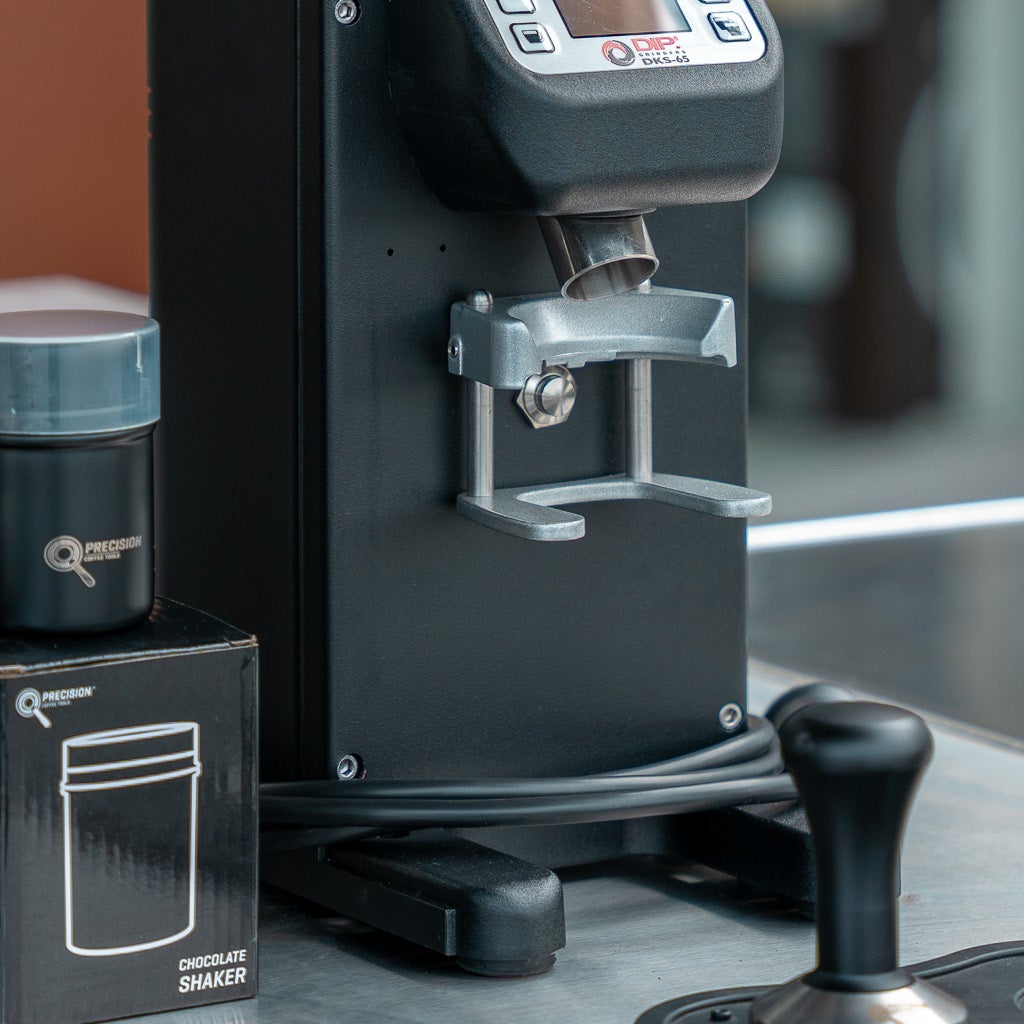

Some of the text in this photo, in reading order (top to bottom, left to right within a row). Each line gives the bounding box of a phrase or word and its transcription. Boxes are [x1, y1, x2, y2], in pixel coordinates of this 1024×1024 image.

[641, 55, 690, 66] DKS-65
[85, 535, 142, 554] PRECISION
[42, 686, 92, 702] PRECISION
[179, 949, 247, 971] CHOCOLATE
[178, 967, 247, 993] SHAKER
